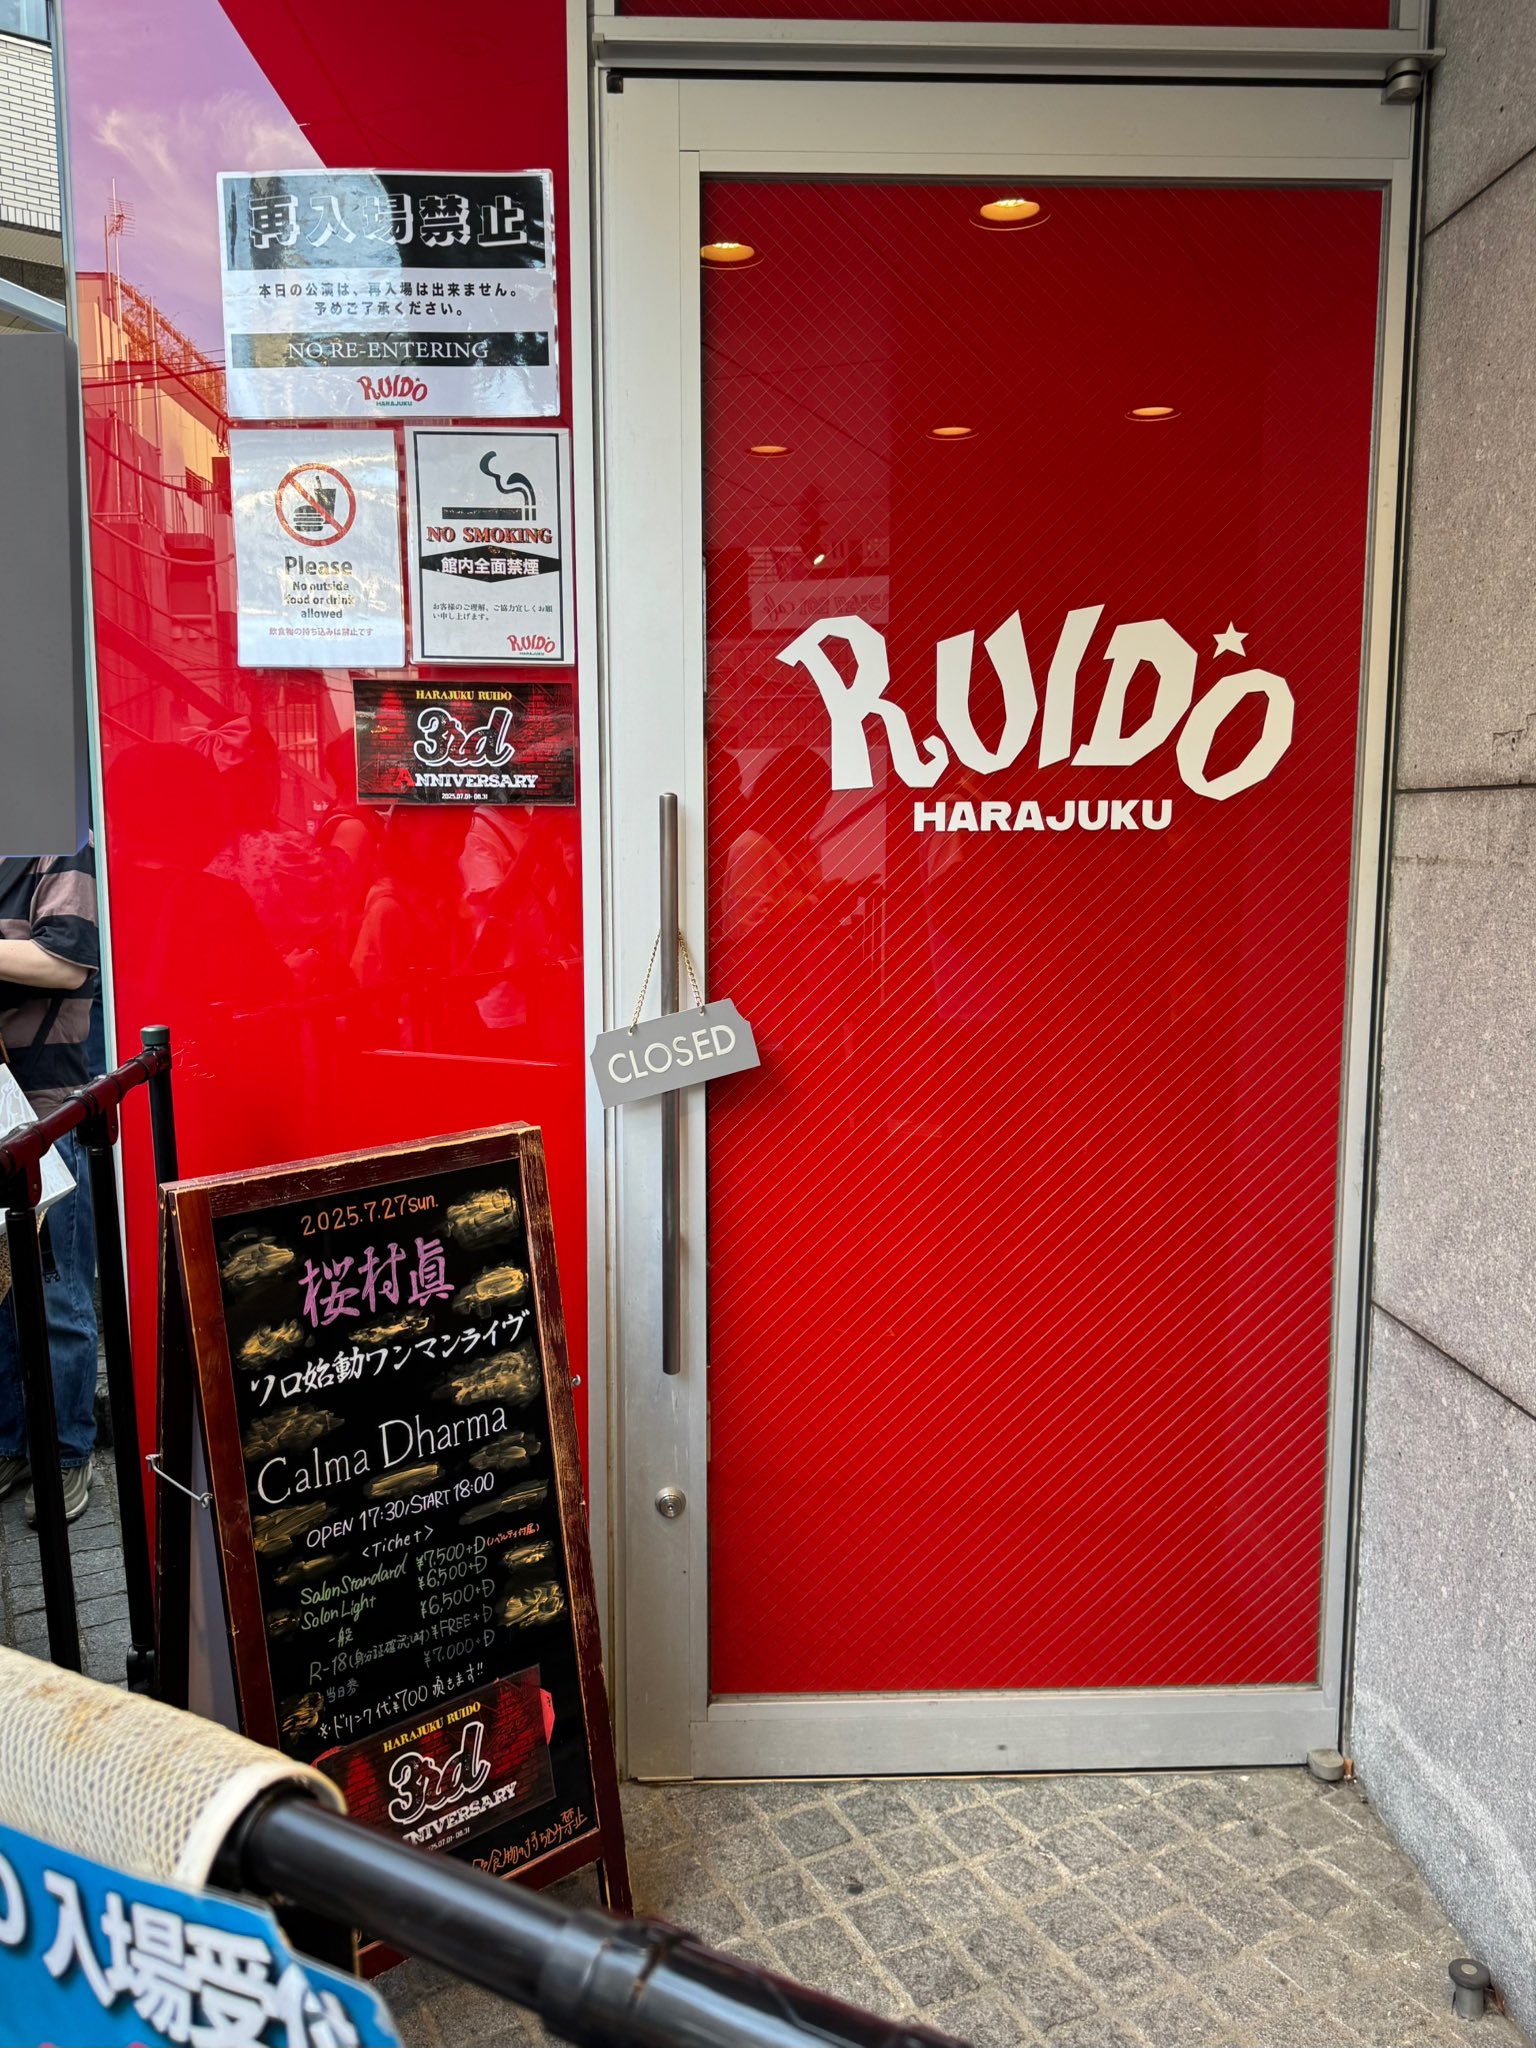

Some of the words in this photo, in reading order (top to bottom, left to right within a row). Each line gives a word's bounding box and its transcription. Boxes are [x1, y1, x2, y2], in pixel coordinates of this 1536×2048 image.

[248, 192, 529, 249] 再入場禁止
[258, 281, 518, 298] 本日の公演は、再入場は出来ません。
[314, 301, 464, 316] 予めご了承ください。
[287, 342, 323, 359] NO
[329, 341, 489, 359] RE-ENTERING
[356, 374, 428, 402] RUIDO
[426, 526, 456, 543] NO
[462, 526, 553, 545] SMOKING
[284, 555, 353, 576] Please
[440, 556, 540, 576] 館内全面禁煙
[292, 581, 307, 591] No
[309, 580, 349, 592] outside
[312, 595, 324, 605] or
[432, 602, 554, 613] お客様のご理解、ご協力宜しくお願
[300, 607, 344, 619] allowed
[432, 611, 490, 622] い申し上げます。
[268, 626, 375, 637] 飲食物の持ち込みは禁止です
[506, 634, 556, 654] RUIDO
[415, 689, 475, 701] HARAJUKU
[477, 690, 513, 702] RUIDO
[774, 603, 1296, 801] RUIDO
[413, 706, 516, 768] 3rd
[393, 767, 539, 789] ANNIVERSARY
[913, 798, 1173, 833] HARAJUKU
[607, 1024, 737, 1084] CLOSED
[297, 1236, 456, 1329] 桜村眞
[250, 1308, 531, 1408] ソロ始動ワンマンライヴ
[256, 1446, 371, 1505] Calma
[377, 1406, 508, 1469] Dharma
[305, 1516, 355, 1549] OPEN
[452, 1471, 495, 1502] 18:00
[326, 1677, 360, 1704] 当日券
[382, 1716, 446, 1754] HARAJUKU
[446, 1700, 482, 1725] RUIDO
[387, 1720, 492, 1826] 3rd
[401, 1780, 518, 1845] NIVERSARY
